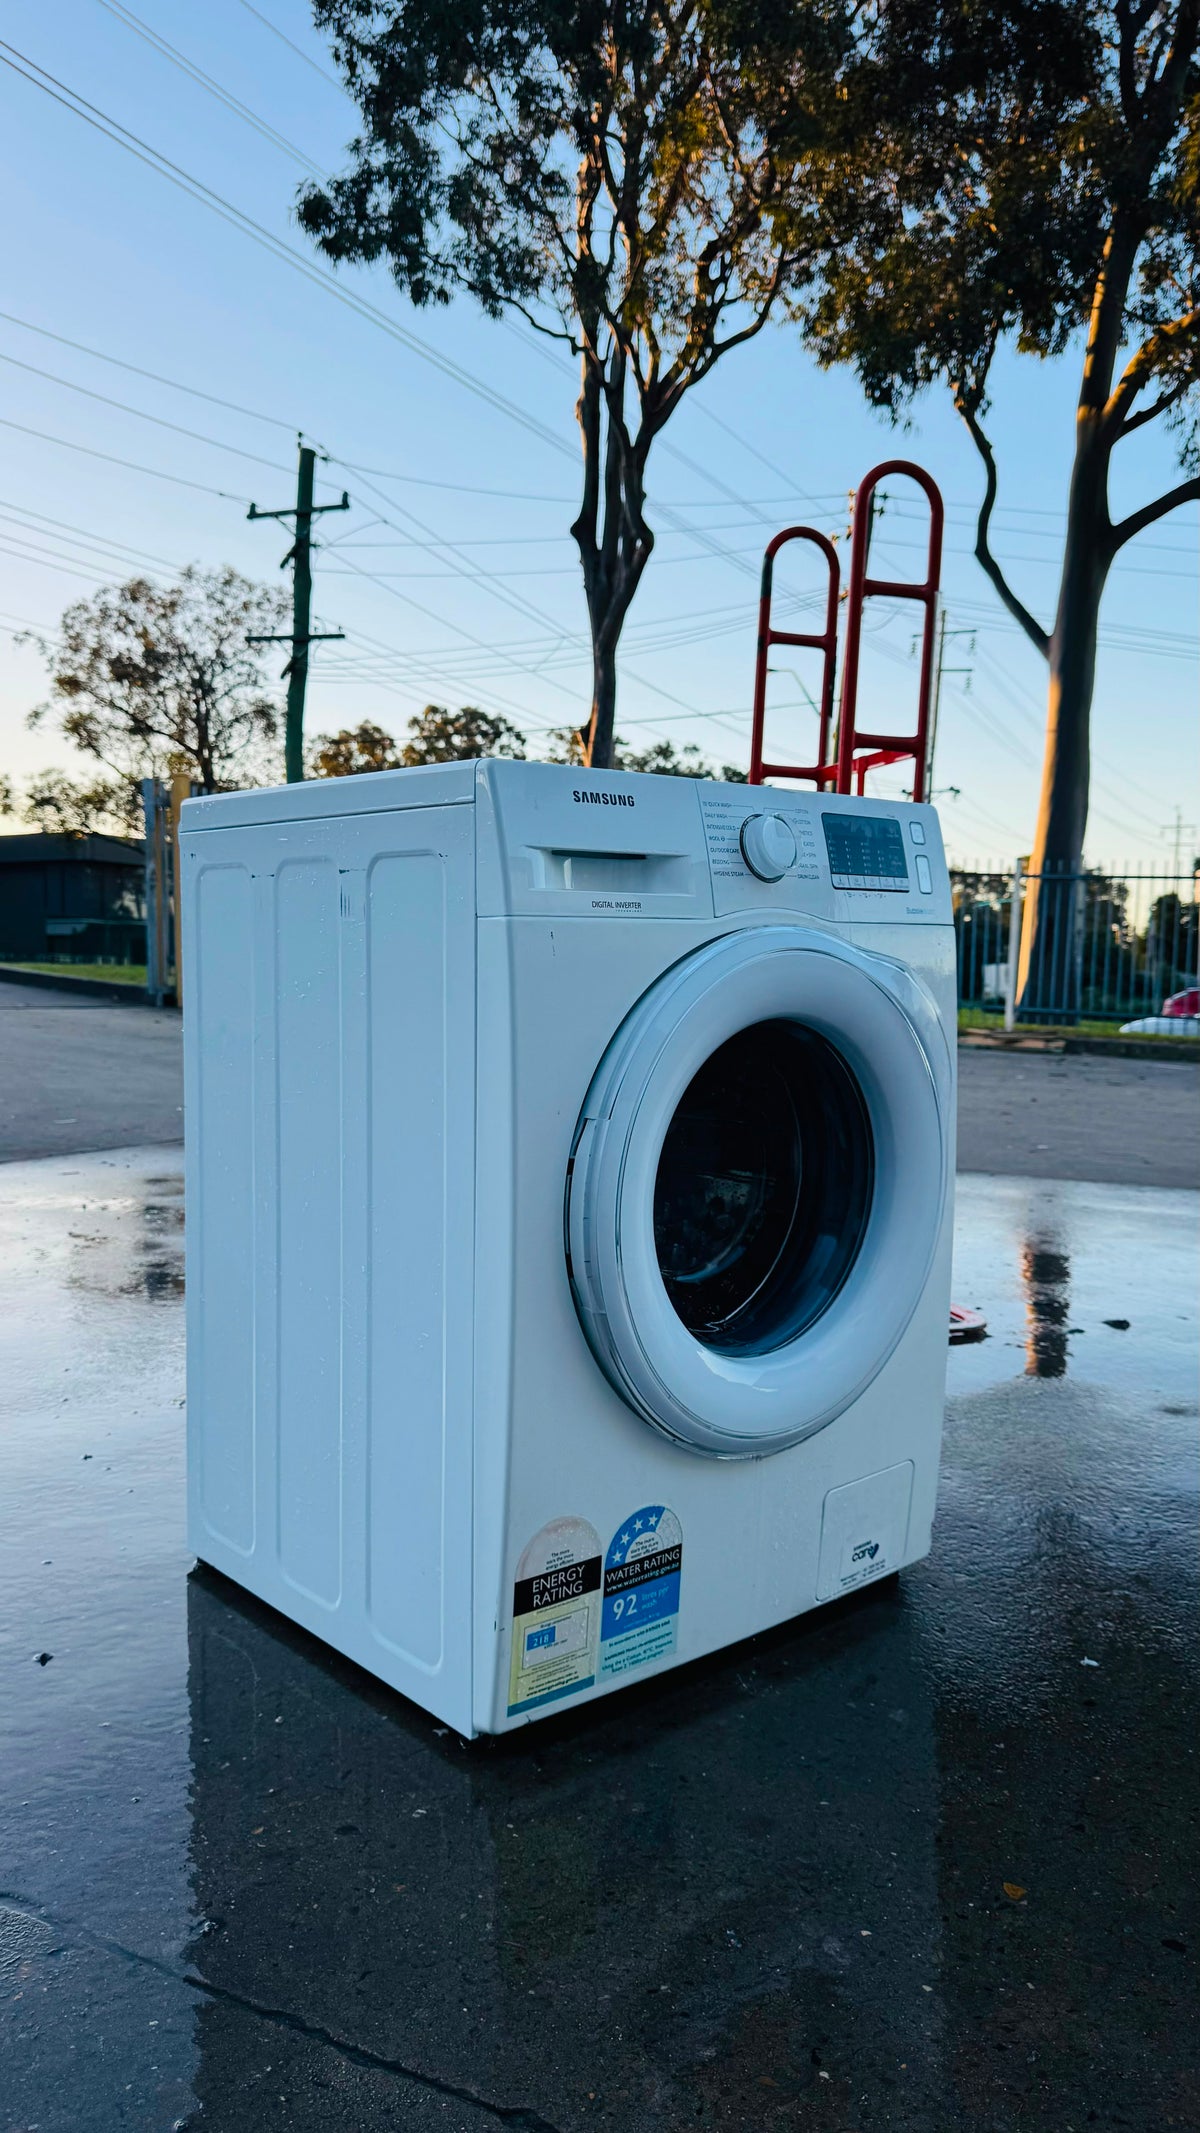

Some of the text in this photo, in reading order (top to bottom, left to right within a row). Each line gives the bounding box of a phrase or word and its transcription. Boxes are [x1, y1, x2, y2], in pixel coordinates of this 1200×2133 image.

[572, 790, 635, 807] SAMSUNG
[591, 900, 642, 909] DIGITAL INVERTER
[532, 1564, 585, 1593] ENERGY
[606, 1548, 680, 1583] WATER RATING
[606, 1562, 680, 1592] www.waterrating.gov.au
[533, 1580, 583, 1608] RATING
[613, 1593, 638, 1621] 92
[533, 1634, 549, 1647] 218
